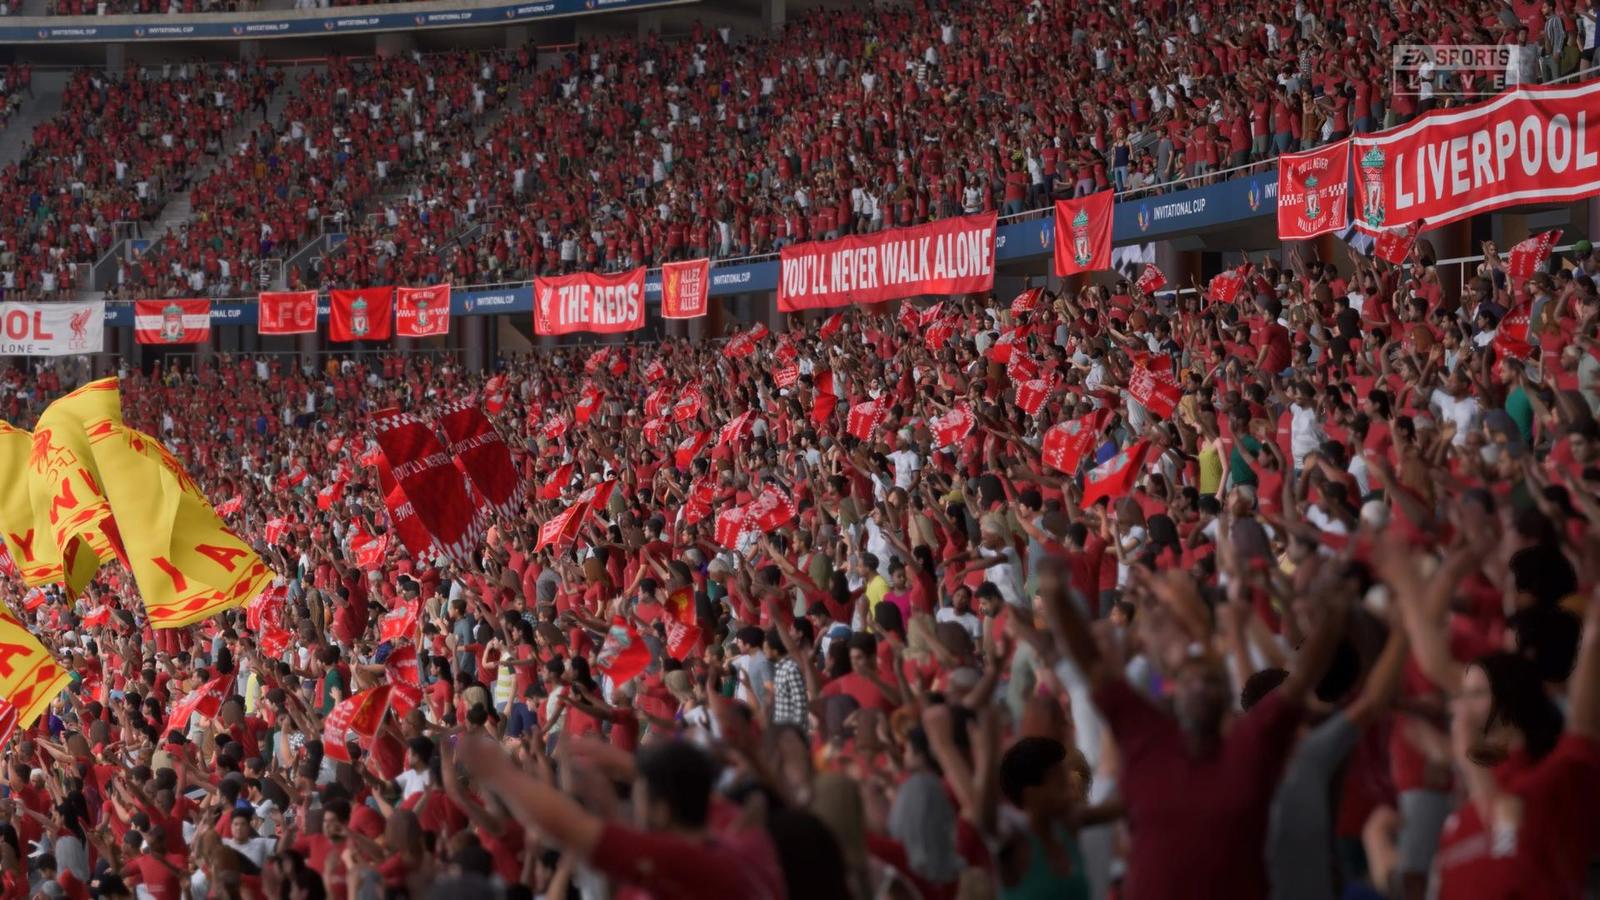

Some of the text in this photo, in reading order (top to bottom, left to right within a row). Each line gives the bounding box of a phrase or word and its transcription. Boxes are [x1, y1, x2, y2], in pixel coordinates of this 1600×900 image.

[1395, 110, 1598, 210] LIVERPOOL
[1153, 198, 1206, 220] INVITATIONAL CUP
[1297, 216, 1312, 233] WALK
[782, 228, 992, 298] YOU'LL NEVER WALK ALONE
[680, 268, 700, 284] ALLEZ
[713, 271, 751, 285] INVITATIONAL CUP
[680, 283, 700, 298] ALLEZ
[477, 294, 515, 306] INVITATIONAL CUP
[558, 282, 639, 326] THE REDS
[680, 296, 700, 311] ALLEZ
[104, 312, 118, 320] CUP
[228, 309, 242, 317] CUP
[263, 301, 312, 328] LFC
